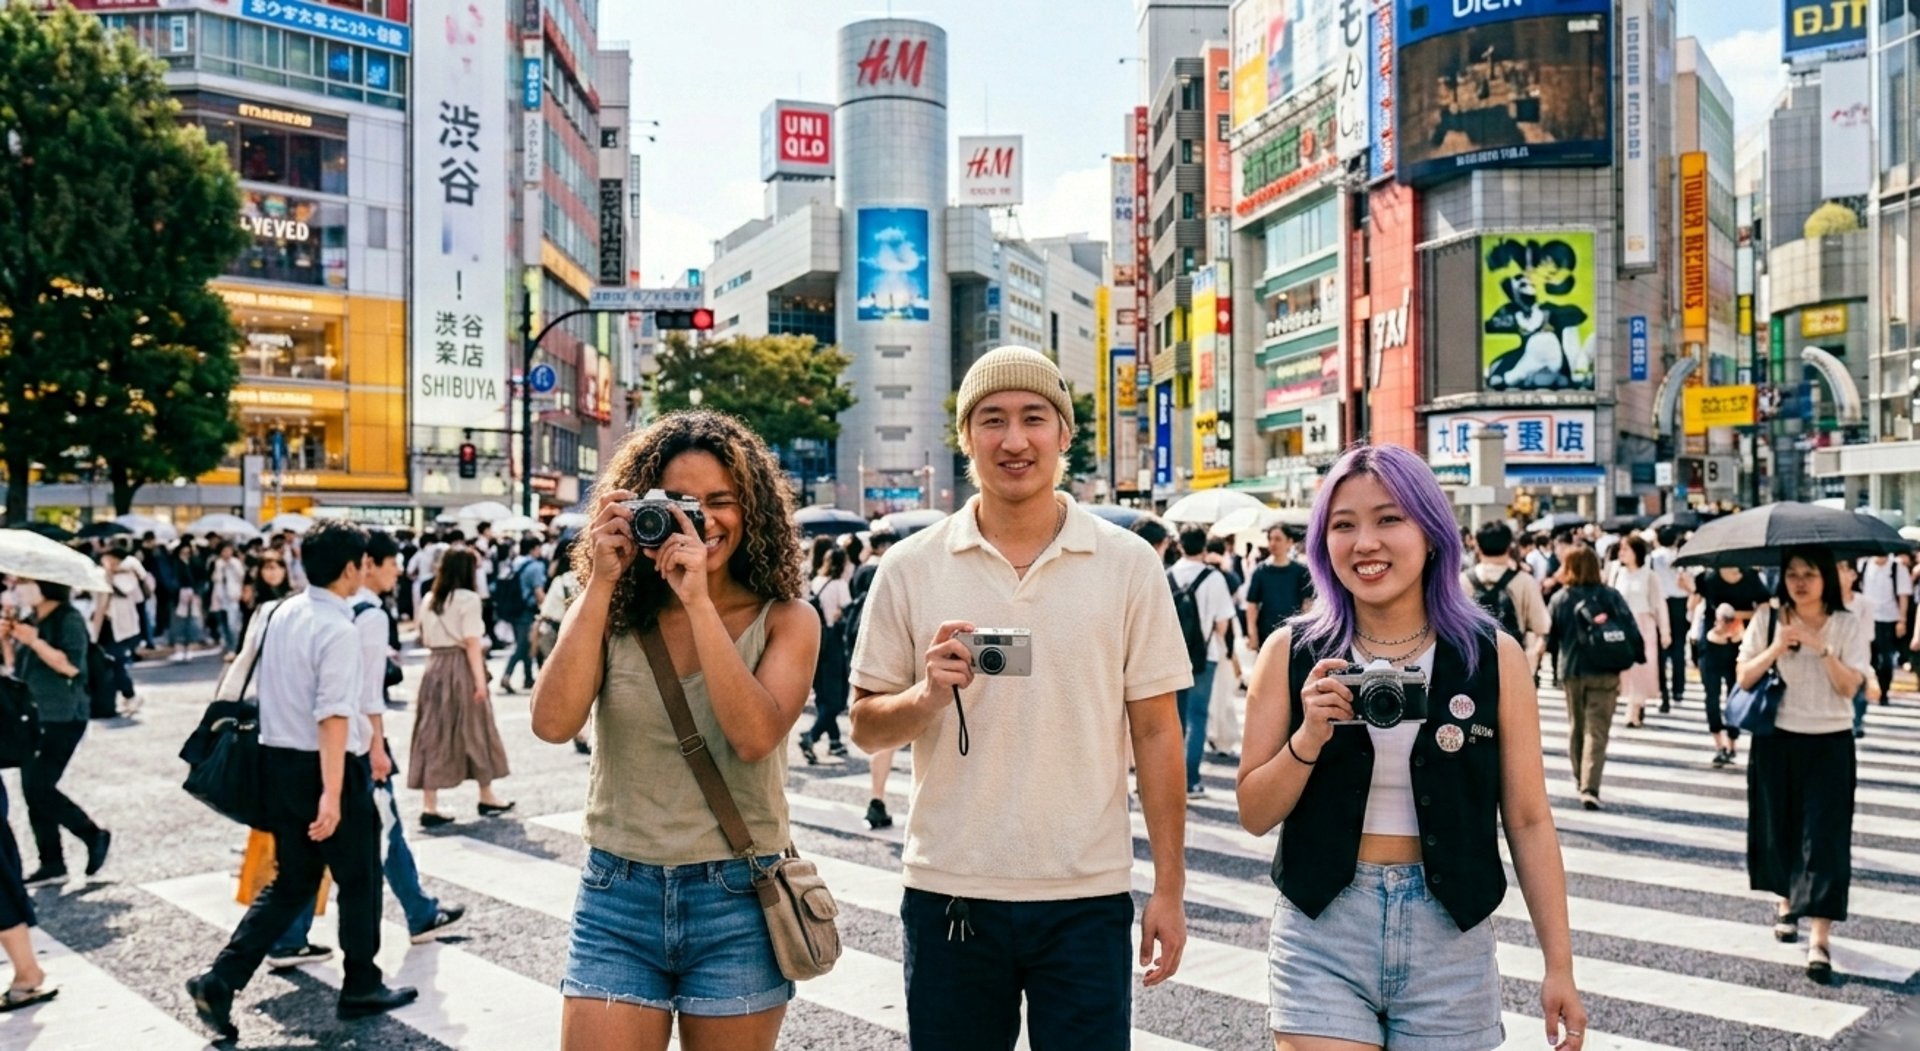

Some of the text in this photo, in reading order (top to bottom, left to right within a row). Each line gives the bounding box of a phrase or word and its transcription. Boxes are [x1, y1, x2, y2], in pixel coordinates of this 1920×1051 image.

[857, 38, 928, 88] H&M
[784, 114, 822, 137] UNI
[438, 100, 480, 207] 渋谷
[966, 146, 1014, 179] H&M
[421, 373, 497, 401] SHIBUYA
